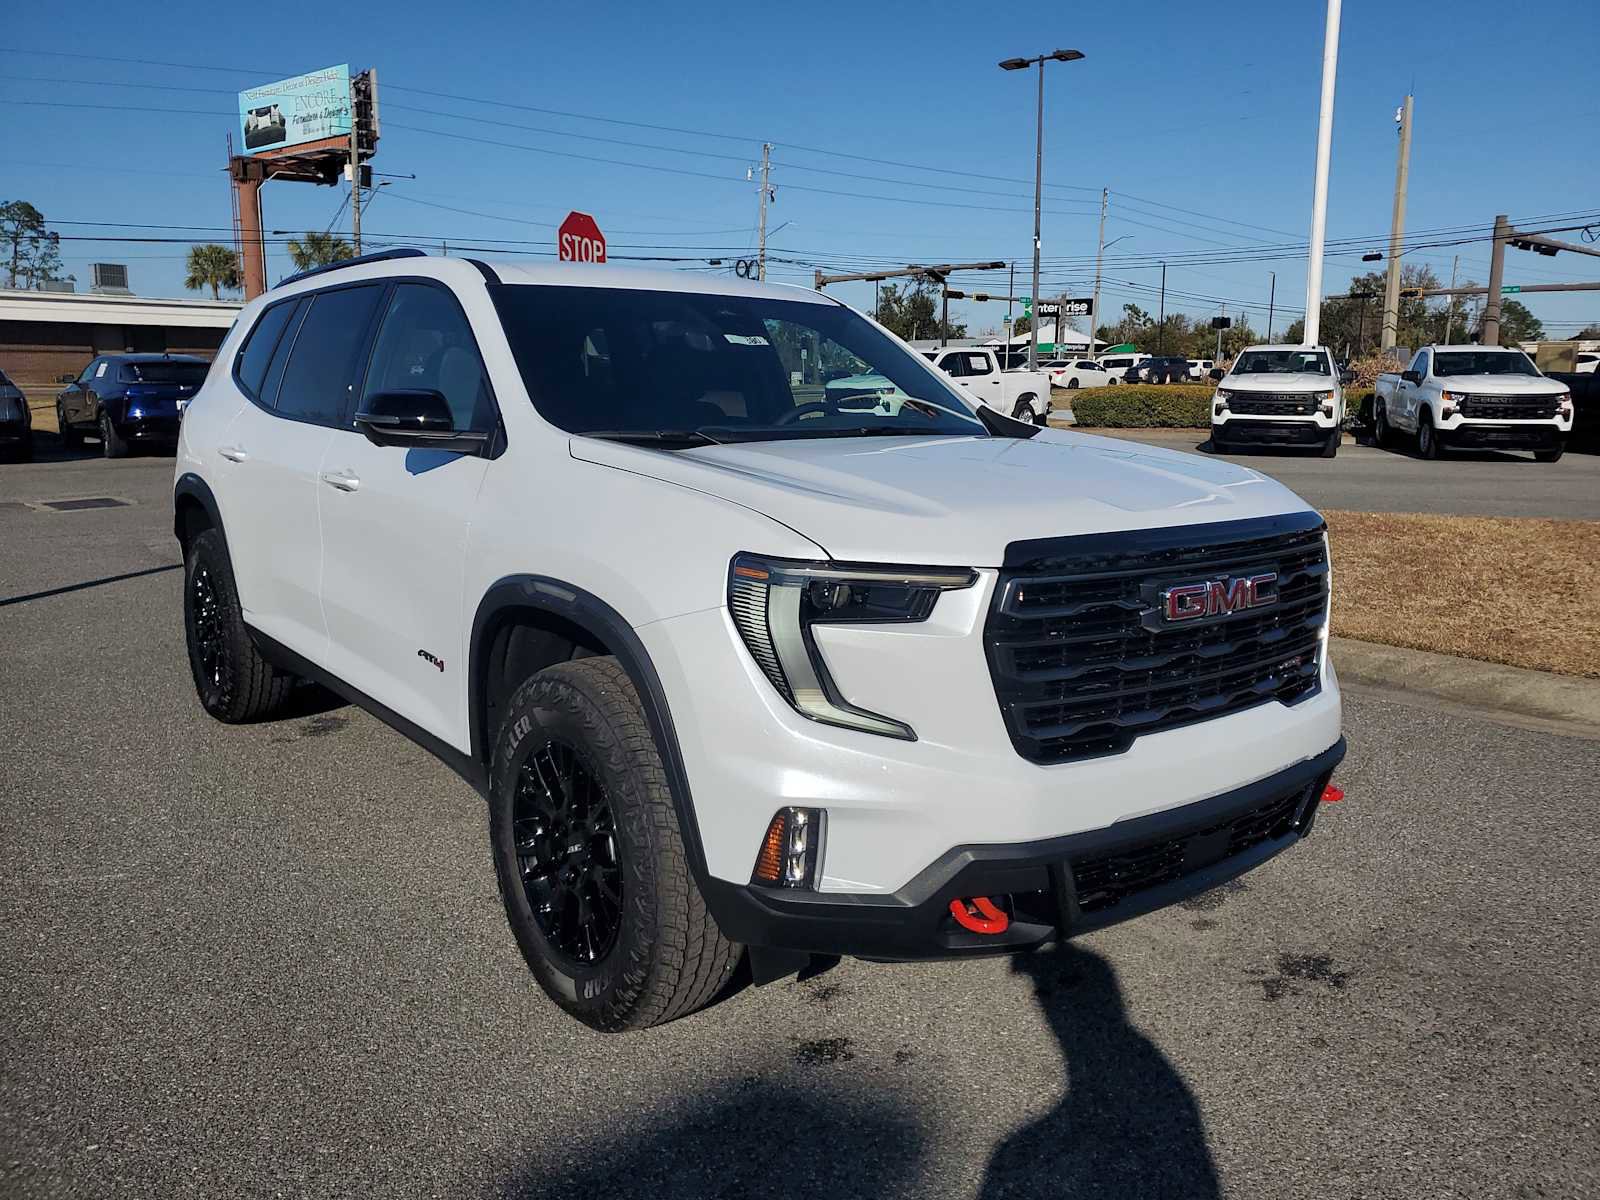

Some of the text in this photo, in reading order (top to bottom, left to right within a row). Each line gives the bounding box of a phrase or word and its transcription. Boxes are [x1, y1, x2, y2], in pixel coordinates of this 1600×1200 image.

[295, 88, 336, 111] ENCORE
[562, 233, 604, 263] STOP
[1167, 572, 1278, 620] GMC
[417, 649, 445, 673] AT4
